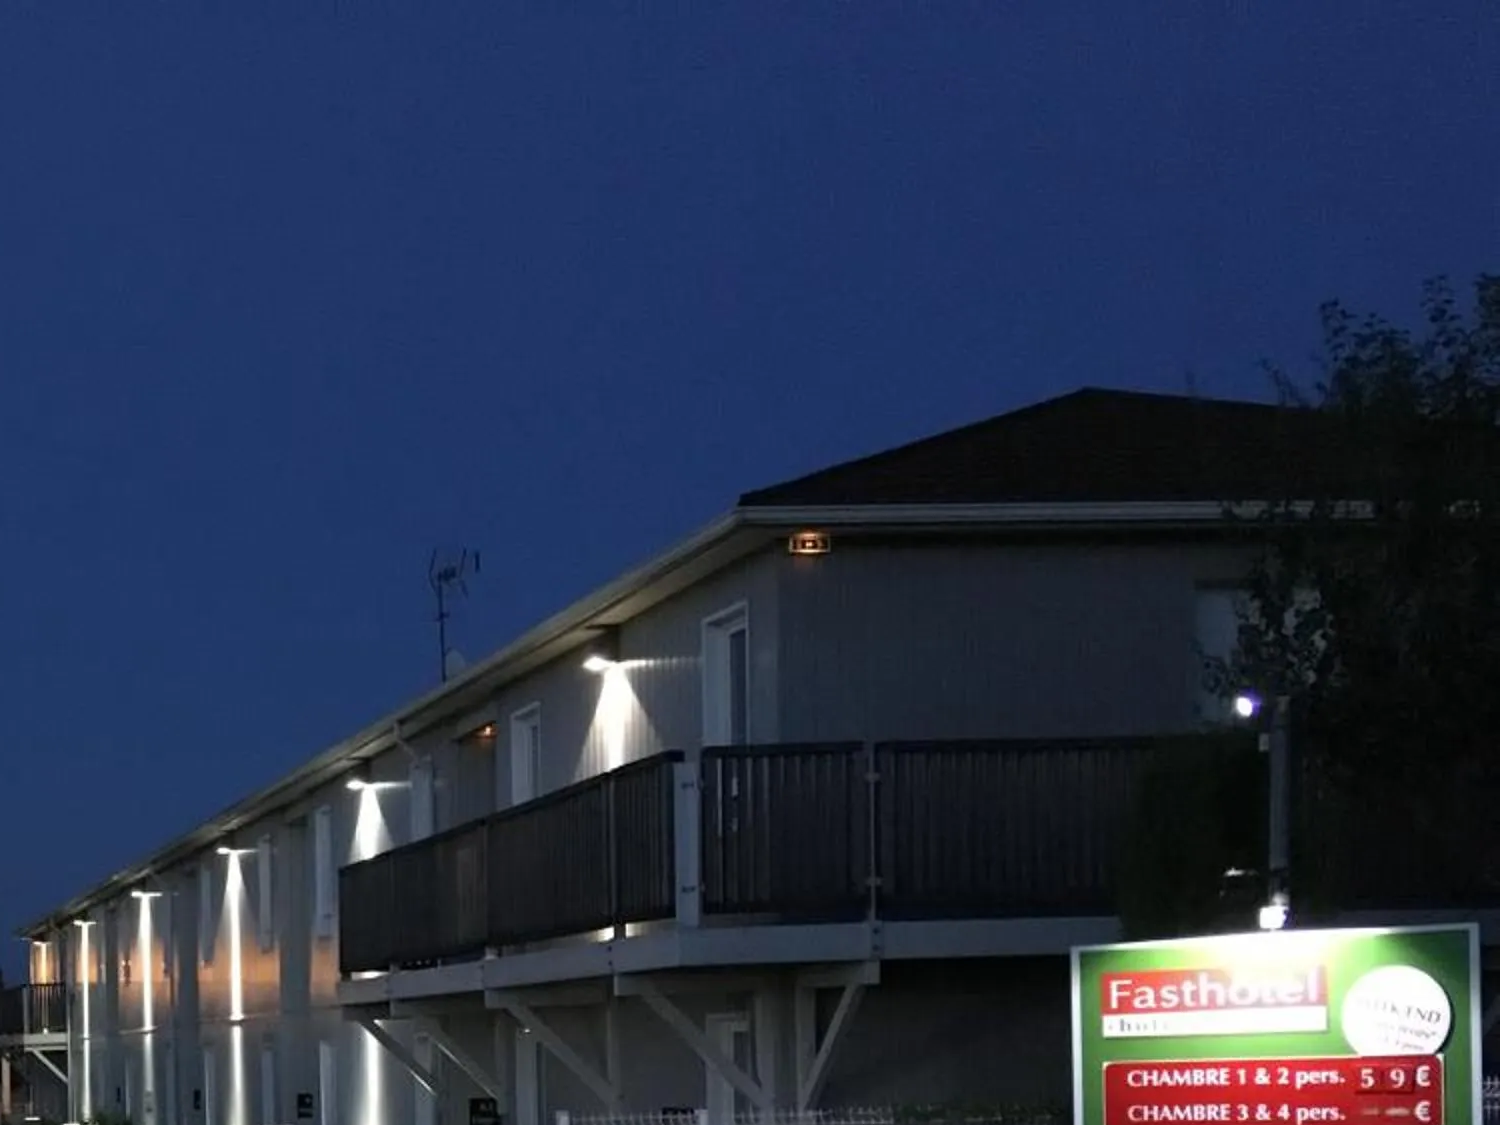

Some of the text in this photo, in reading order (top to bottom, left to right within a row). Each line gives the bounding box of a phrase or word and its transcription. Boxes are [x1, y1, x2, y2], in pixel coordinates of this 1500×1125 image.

[1109, 967, 1319, 1009] Fasthotel
[1126, 1068, 1231, 1087] CHAMBRE
[1237, 1069, 1247, 1086] 1
[1254, 1067, 1271, 1086] &
[1277, 1067, 1290, 1085] 2
[1295, 1069, 1346, 1090] pers.
[1126, 1101, 1431, 1125] CHAMBRE 3 & 4 pers. €
